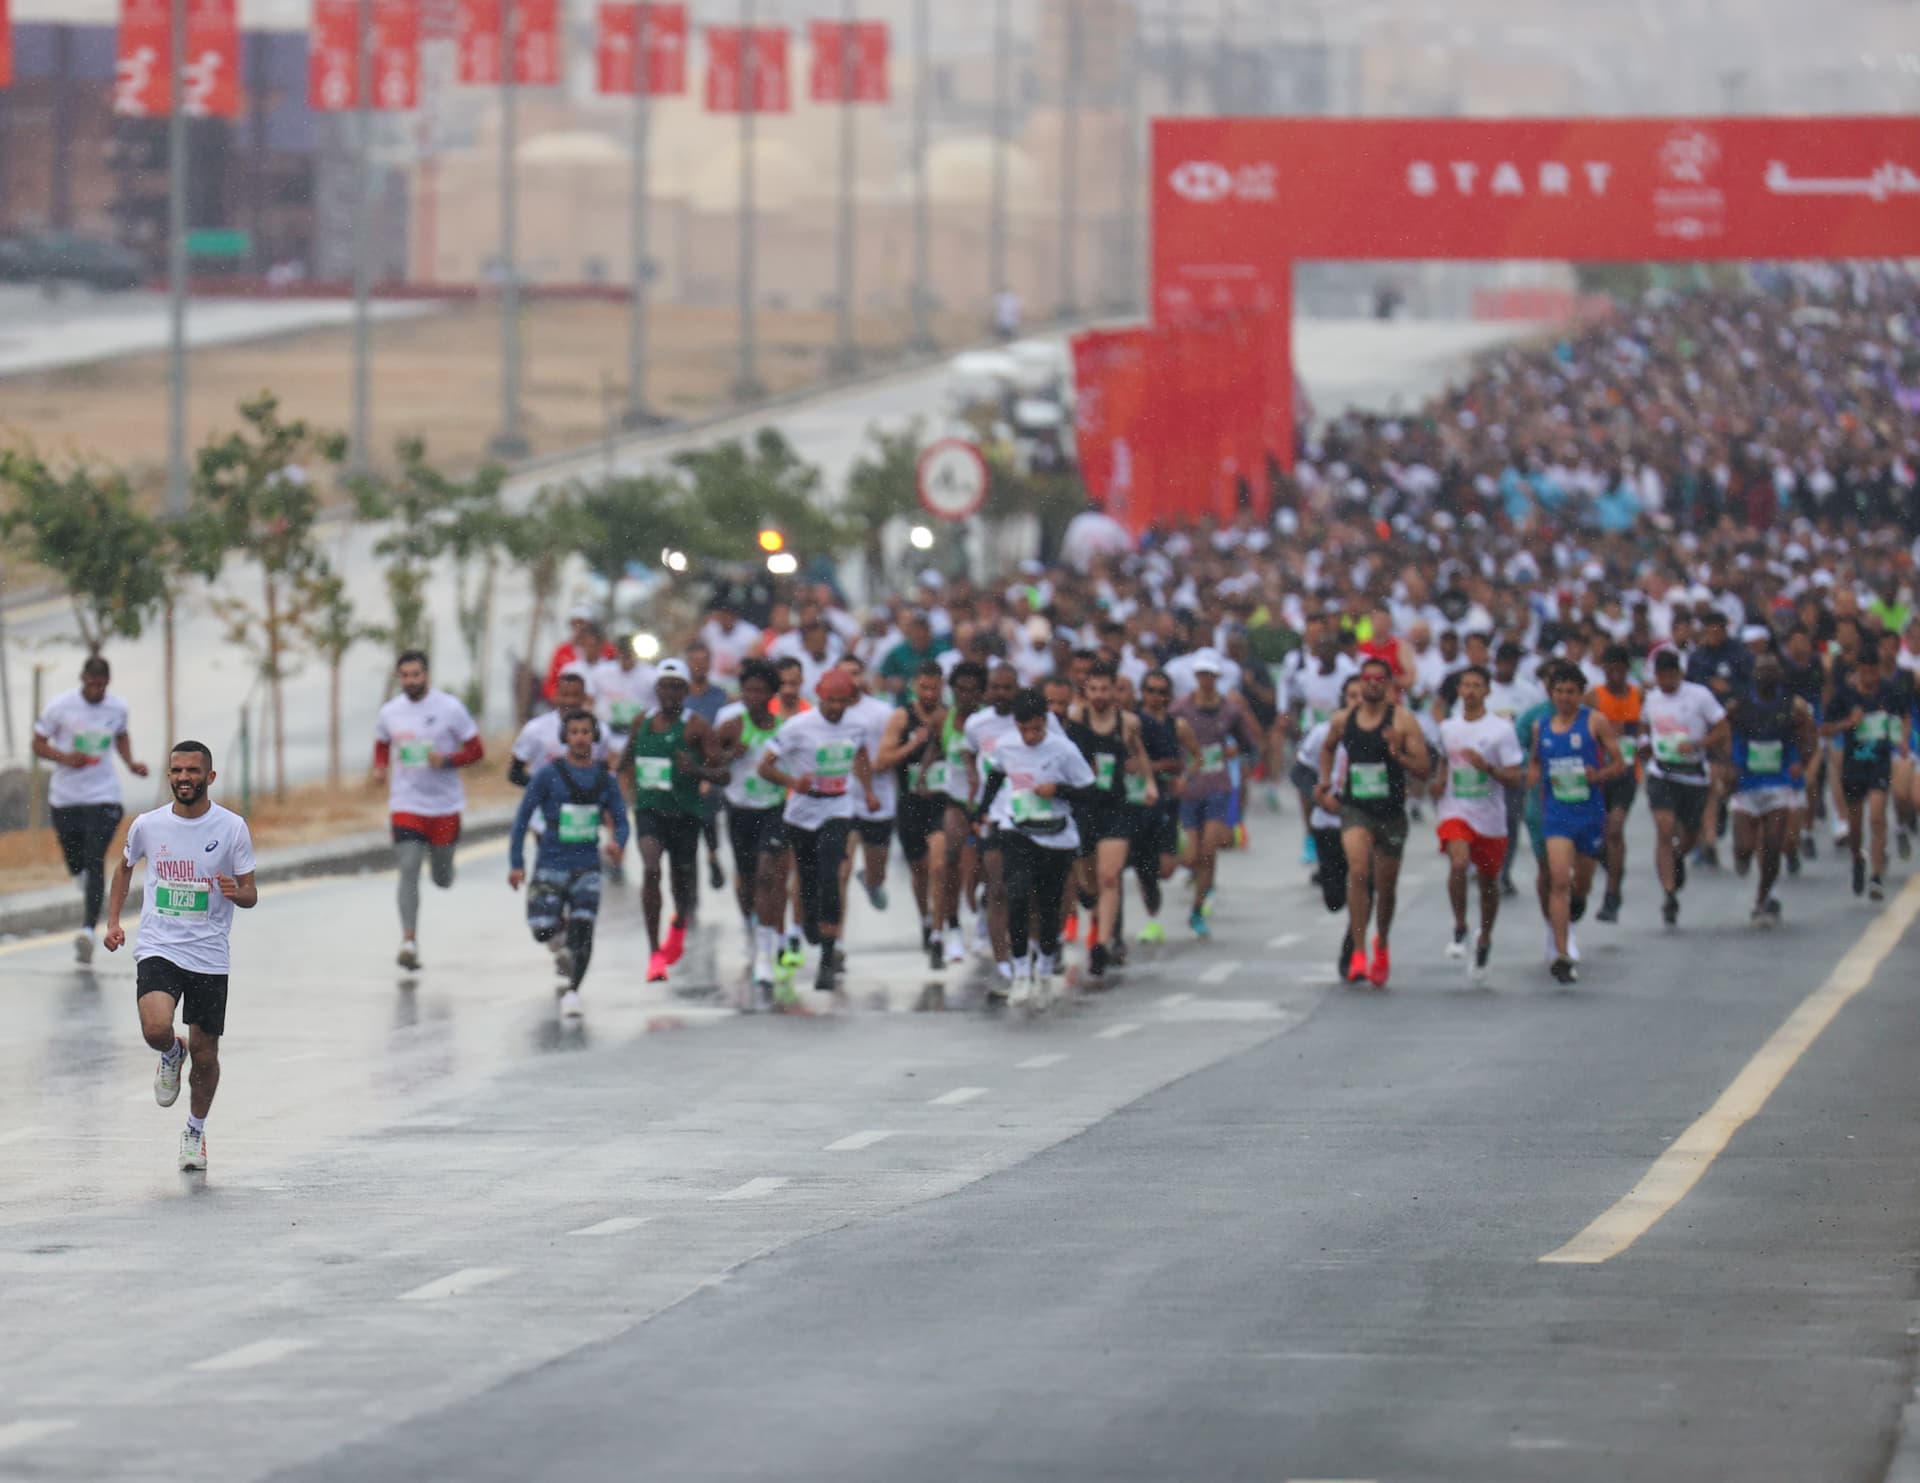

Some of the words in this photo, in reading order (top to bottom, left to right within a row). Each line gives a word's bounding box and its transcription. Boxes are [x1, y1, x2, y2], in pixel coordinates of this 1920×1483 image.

[1407, 160, 1613, 197] START
[156, 860, 194, 881] RIYADH
[168, 890, 195, 908] 10239
